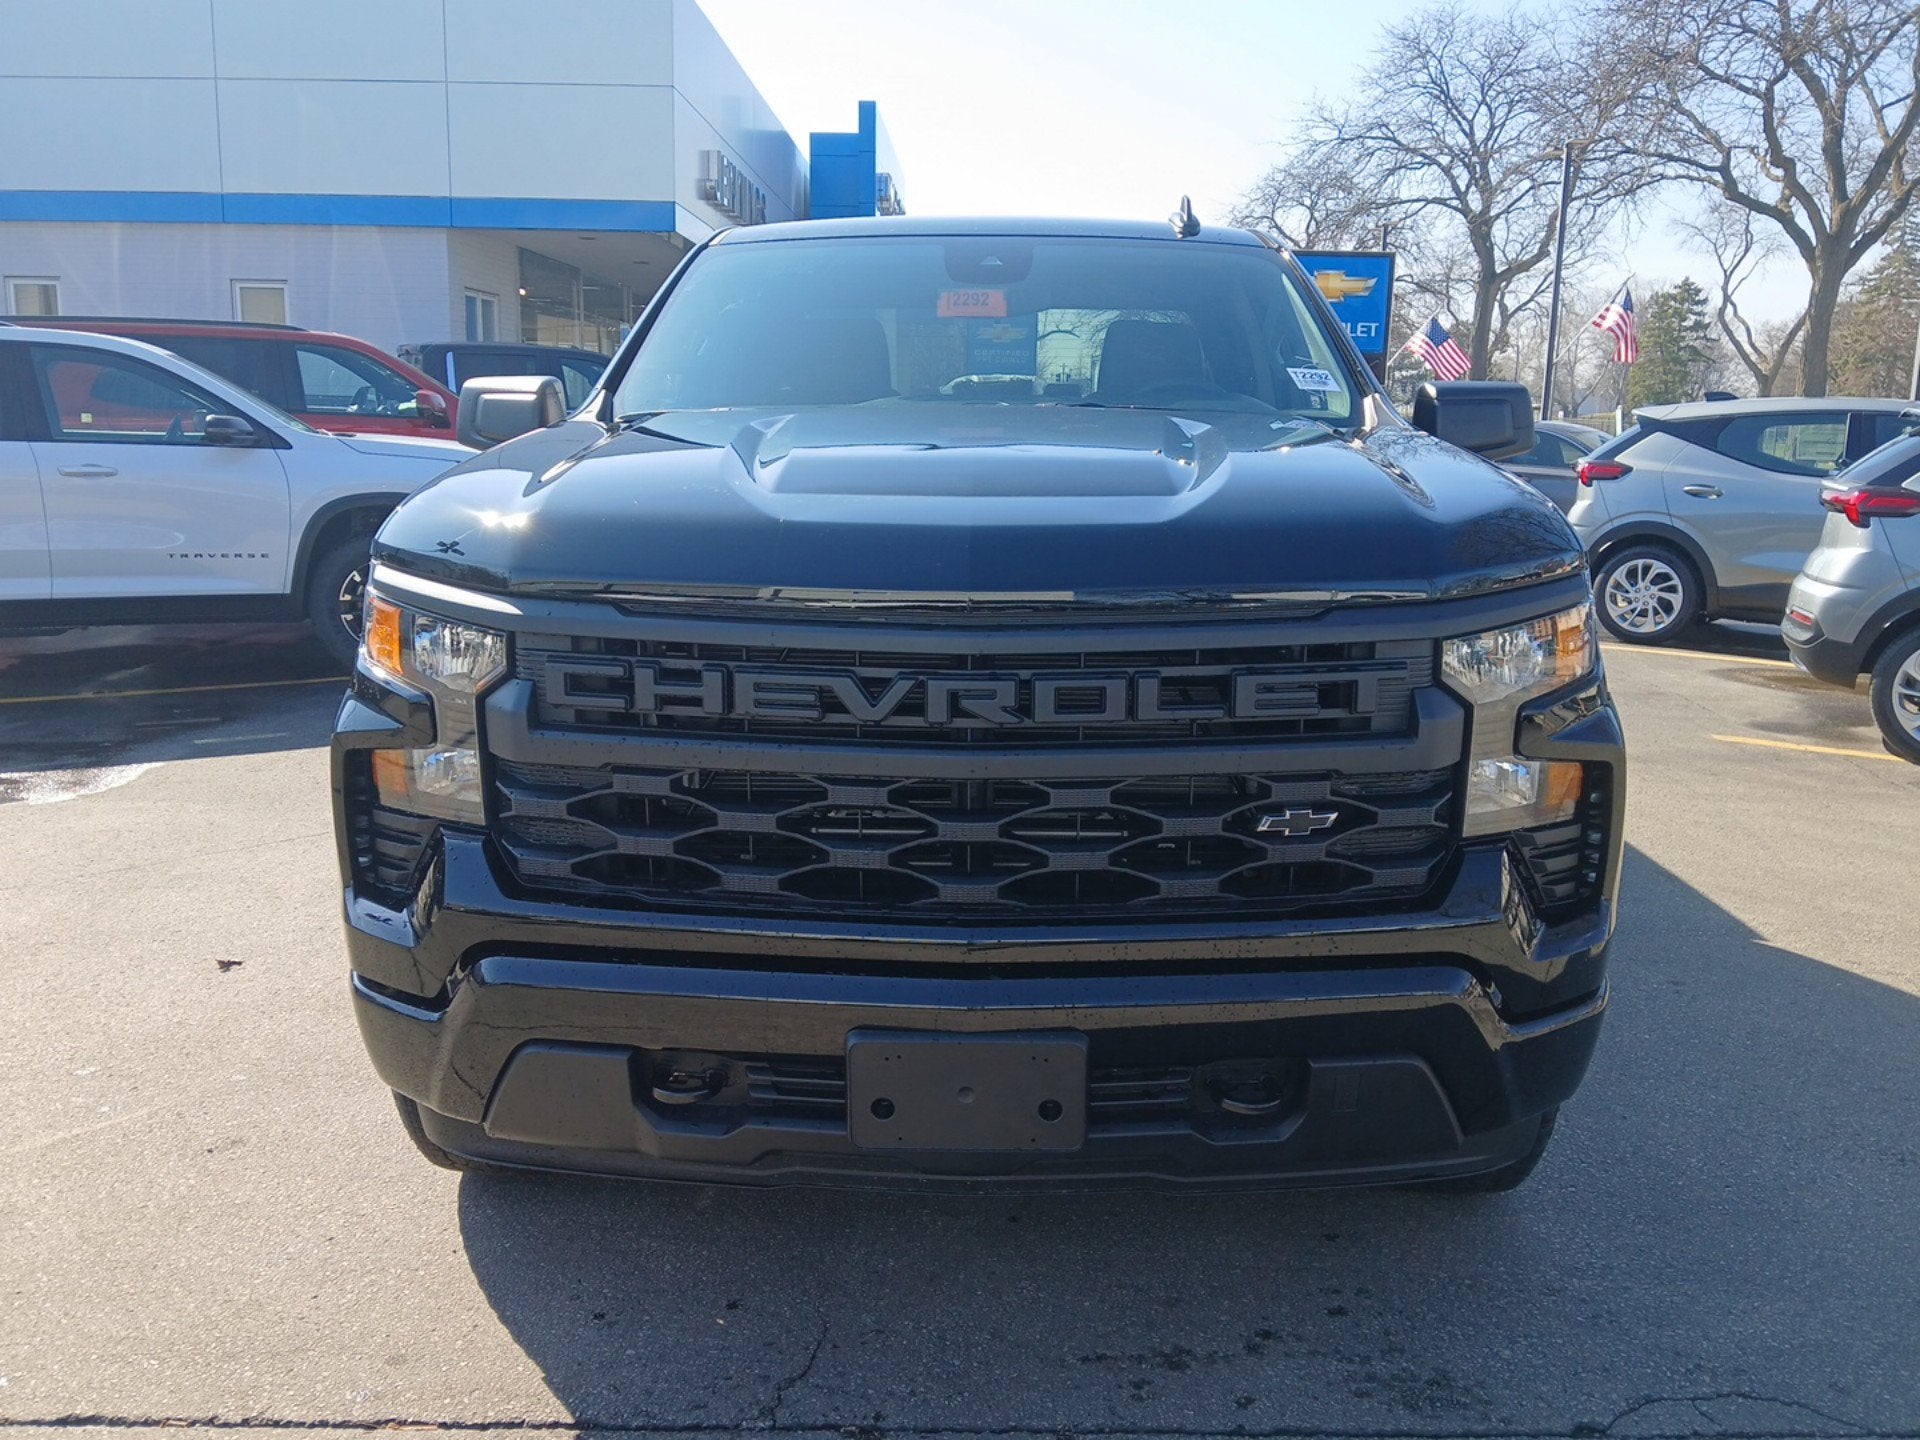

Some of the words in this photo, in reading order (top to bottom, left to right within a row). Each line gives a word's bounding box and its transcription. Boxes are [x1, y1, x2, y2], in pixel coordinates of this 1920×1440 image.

[1342, 322, 1379, 337] LET
[167, 552, 270, 560] TRAVERSE
[543, 656, 1410, 725] CHEVROLET
